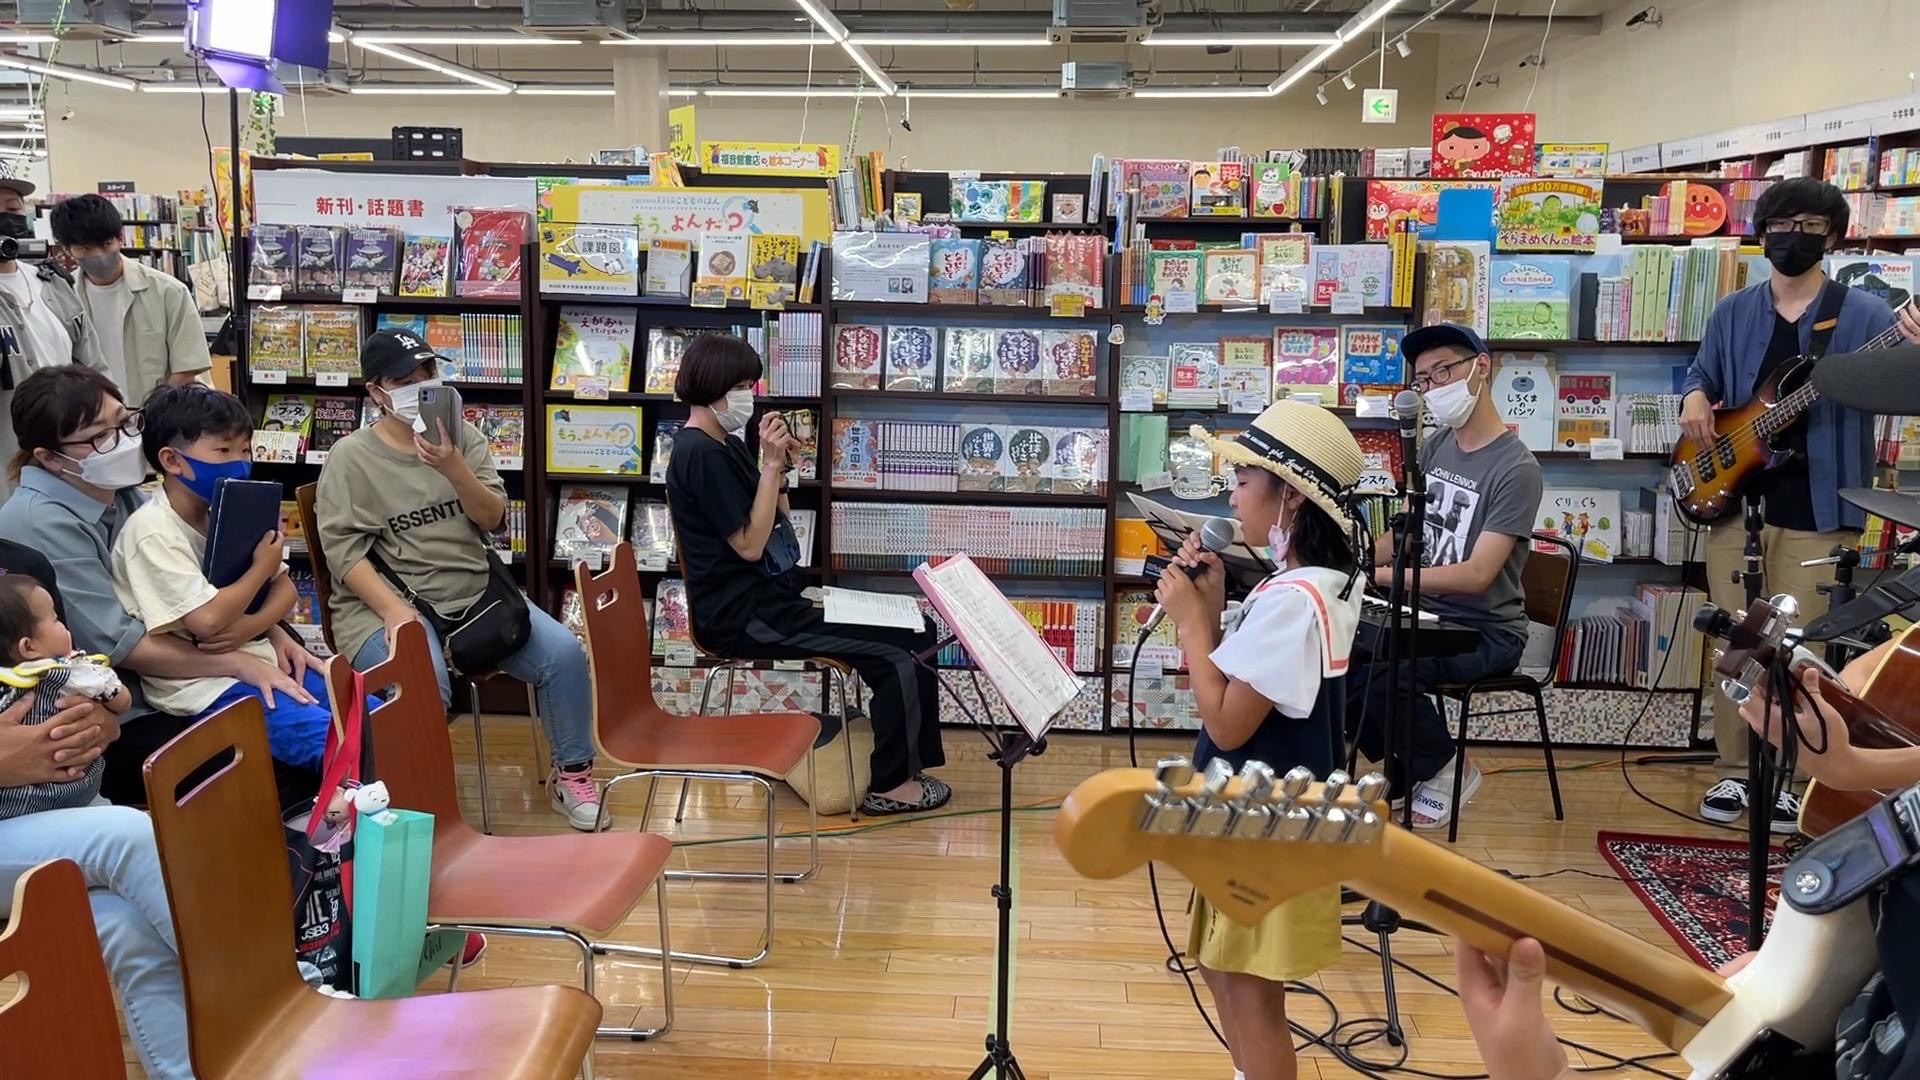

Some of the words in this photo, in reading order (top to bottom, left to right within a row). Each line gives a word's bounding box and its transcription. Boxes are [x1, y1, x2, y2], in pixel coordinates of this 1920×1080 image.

[720, 152, 816, 167] 福音館書店の絵本コーナー
[316, 196, 424, 218] 新刊・話題書
[633, 211, 744, 235] もう、よんだ?
[1500, 231, 1596, 246] そらまめくんの絵本
[394, 333, 420, 350] LA
[1507, 393, 1538, 403] しろくま
[1507, 407, 1536, 416] パンツ
[1560, 404, 1608, 415] いろいろバス
[1430, 466, 1451, 481] JOHN
[1450, 472, 1479, 490] LENNON
[387, 499, 464, 534] ESSENTI
[301, 922, 330, 941] JSB3
